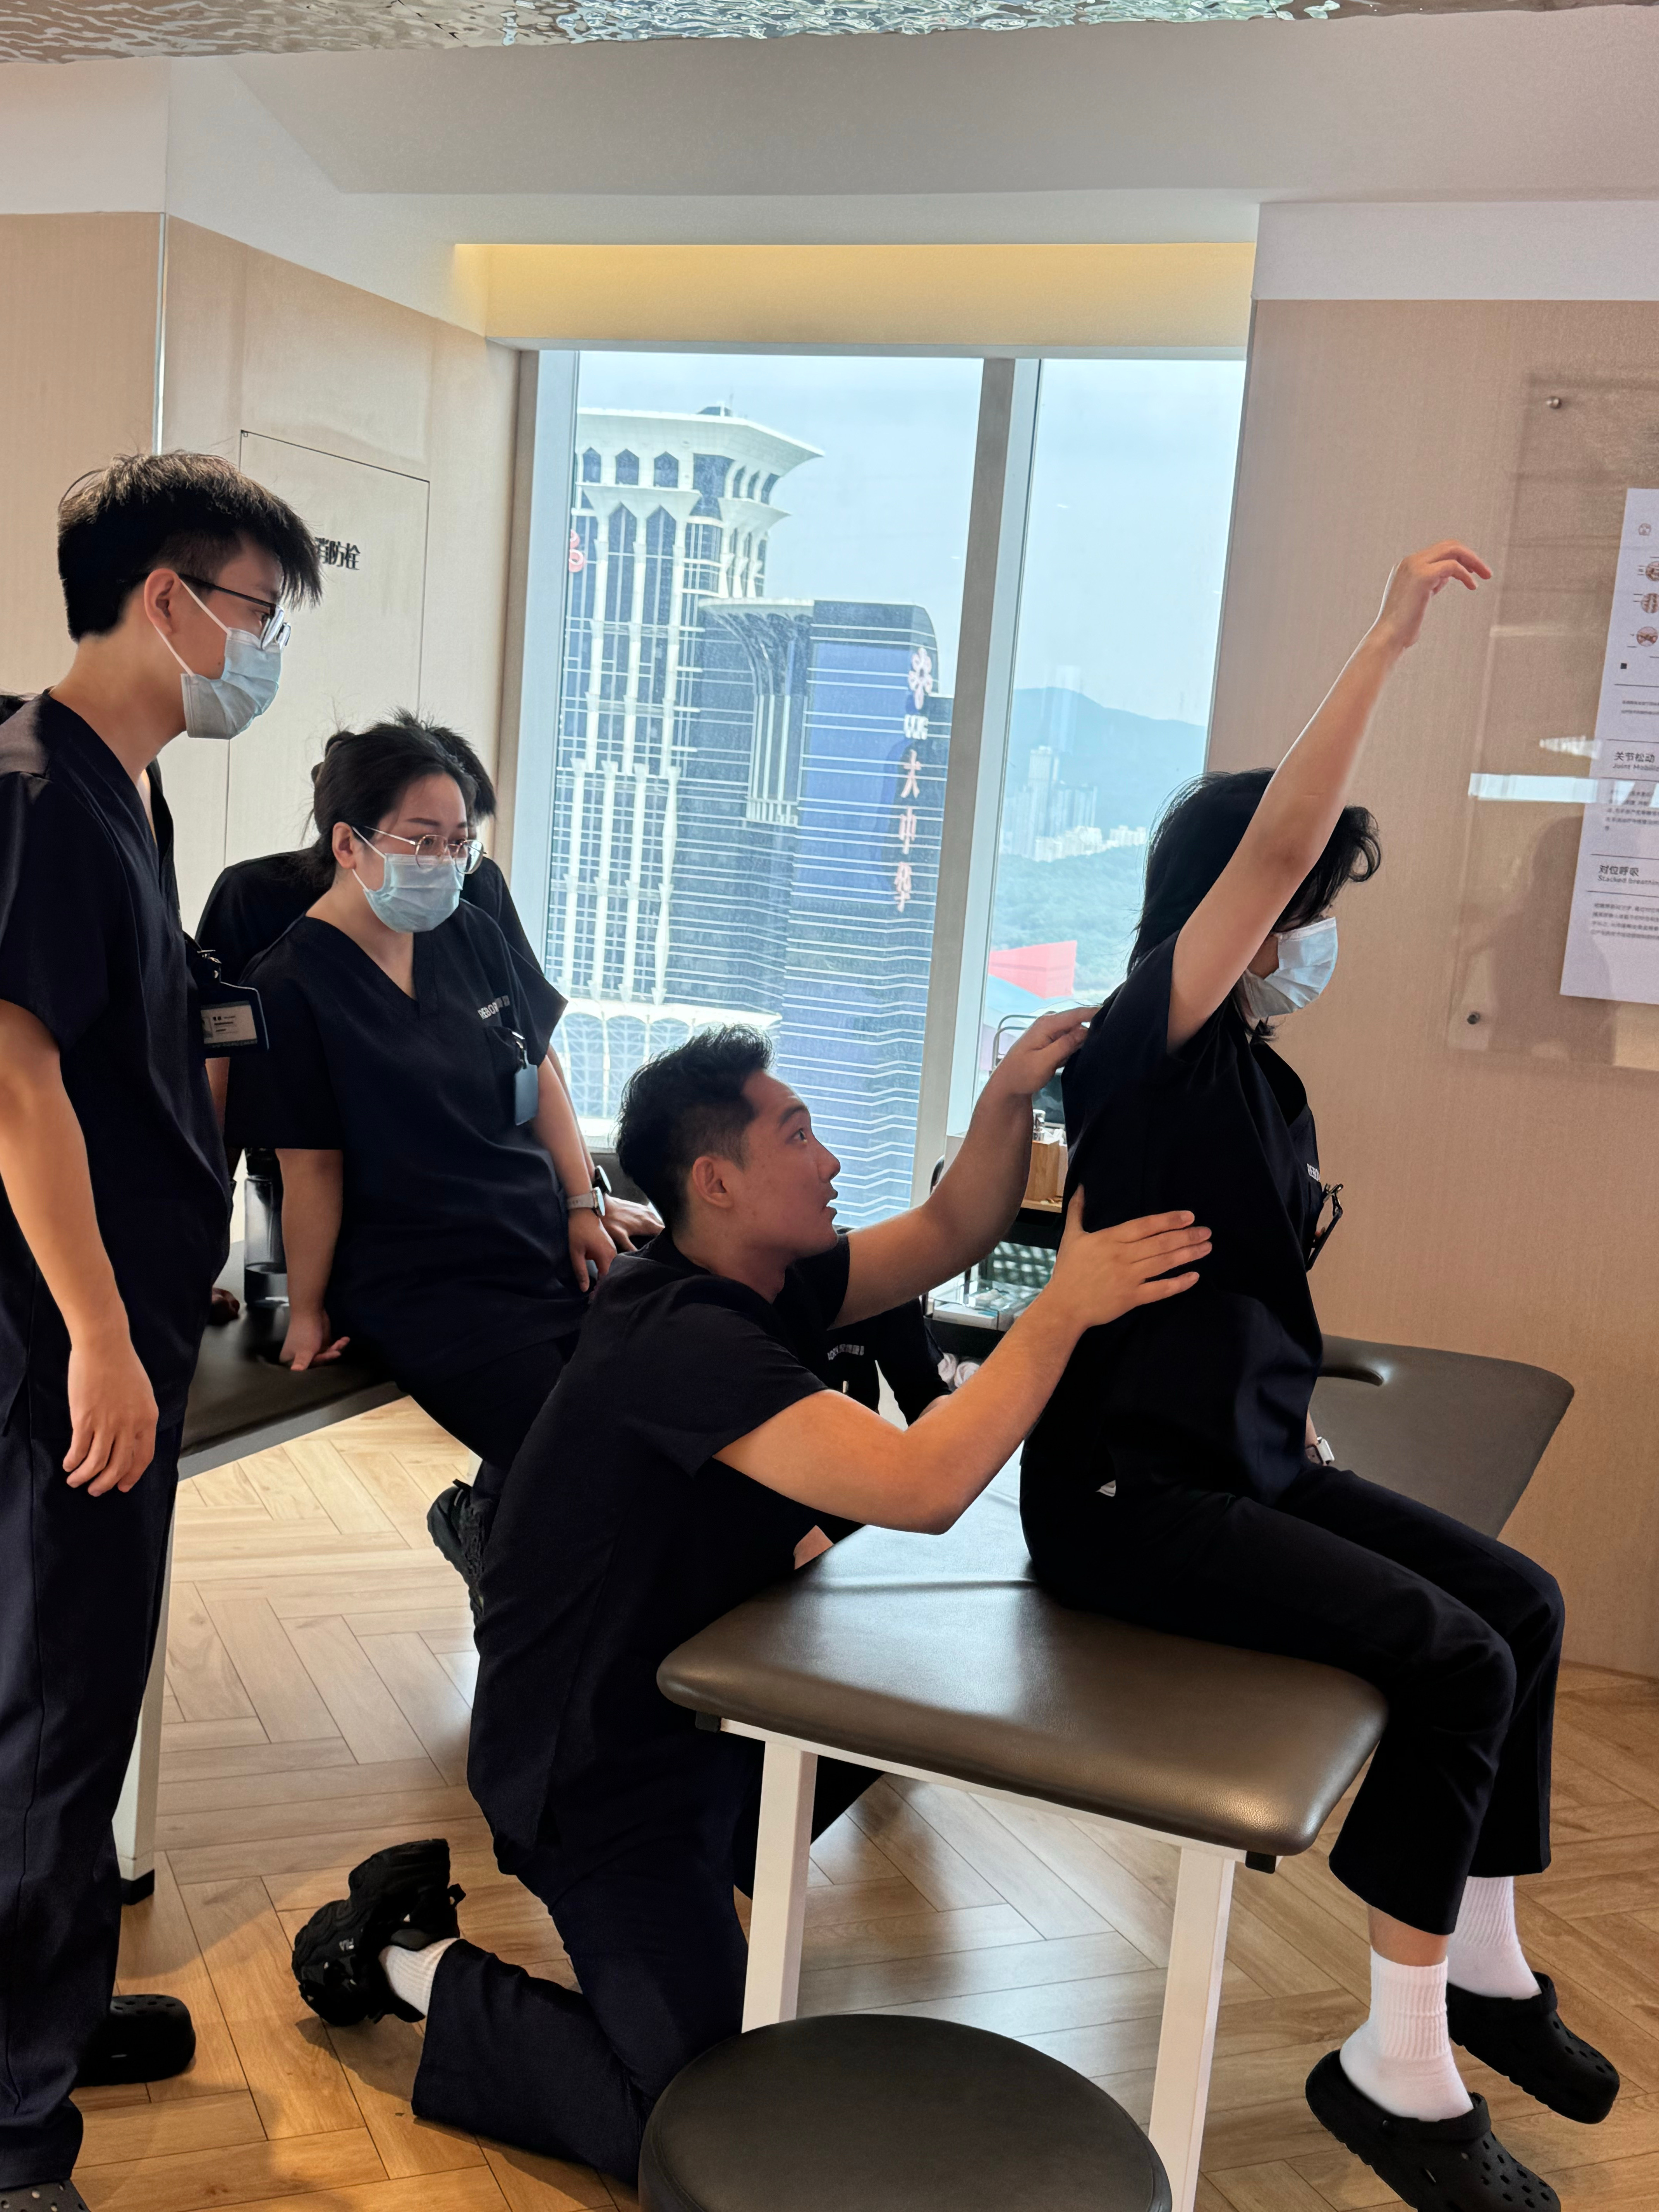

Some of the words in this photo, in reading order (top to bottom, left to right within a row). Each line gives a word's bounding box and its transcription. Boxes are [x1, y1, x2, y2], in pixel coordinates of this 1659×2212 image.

[1614, 752, 1655, 763] 关节松动
[1599, 865, 1639, 876] 对位呼吸
